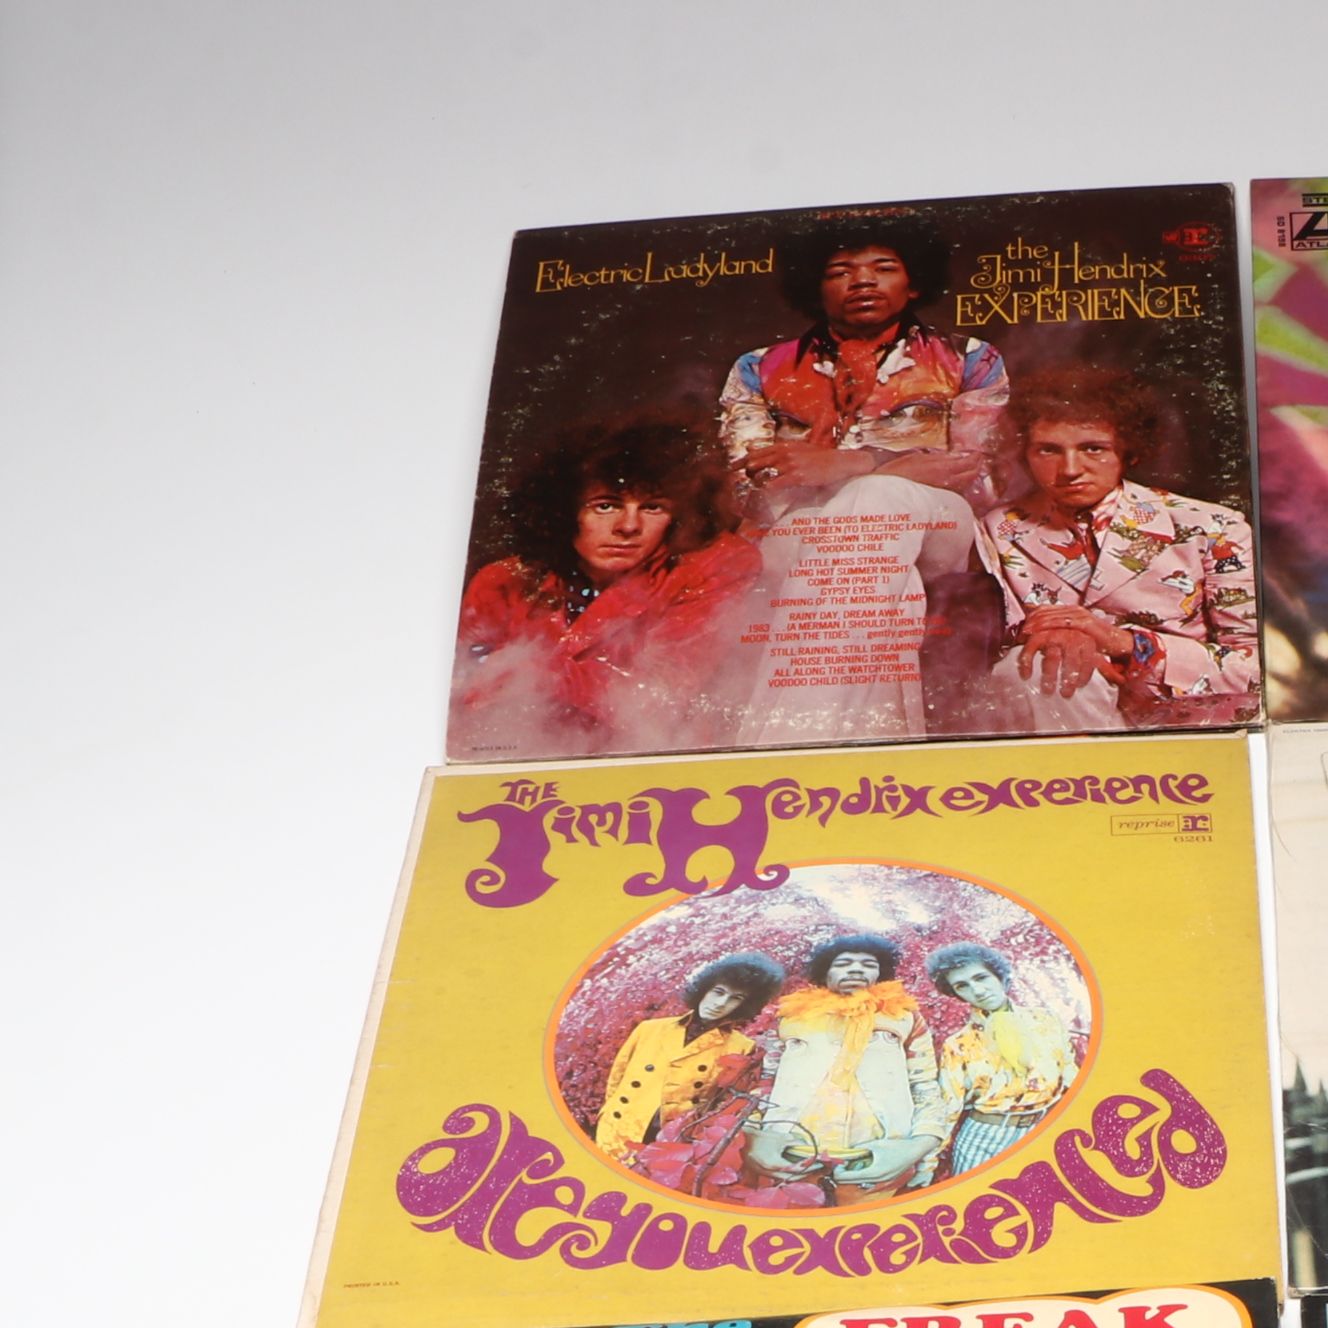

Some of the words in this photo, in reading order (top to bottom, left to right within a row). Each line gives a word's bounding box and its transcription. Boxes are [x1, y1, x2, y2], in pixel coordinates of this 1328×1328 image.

[1005, 237, 1049, 260] the
[536, 260, 644, 293] Electric
[644, 248, 773, 287] Ladyland
[970, 255, 1041, 289] Jimi
[1043, 241, 1167, 293] Hendrix
[956, 280, 1201, 326] EXPERIENCE
[791, 518, 811, 526] AND
[832, 515, 857, 524] GODS
[860, 514, 886, 523] MADE
[888, 513, 911, 521] LOVE
[772, 528, 790, 536] YOU
[792, 527, 816, 535] EVER
[818, 526, 842, 534] BEEN
[861, 524, 904, 532] ELECTRIC
[801, 534, 859, 544] CROSSTOWN
[862, 533, 900, 542] TRAFFIC
[816, 544, 855, 553] VOODOO
[857, 543, 884, 551] CHILE
[799, 559, 829, 567] LITTLE
[832, 558, 855, 566] MISS
[857, 556, 899, 565] STRANGE
[788, 569, 814, 578] LONG
[816, 568, 834, 576] HOT
[837, 566, 878, 575] SUMMER
[880, 565, 909, 573] NIGHT
[807, 578, 833, 586] COME
[836, 577, 850, 585] ON
[852, 576, 879, 585] (PART
[820, 587, 850, 596] GYPSY
[853, 586, 876, 594] EYES
[770, 598, 813, 607] BURNING
[815, 597, 828, 605] OF
[830, 596, 848, 604] THE
[850, 594, 897, 604] MIDNIGHT
[899, 593, 927, 602] LAMP
[789, 612, 817, 621] RAINY
[843, 610, 876, 618] DREAM
[878, 608, 905, 617] AWAY
[787, 623, 797, 631] (A
[798, 621, 840, 630] MERMAN
[848, 619, 886, 628] SHOULD
[889, 618, 914, 626] TURN
[775, 632, 800, 641] TURN
[802, 632, 820, 640] THE
[823, 630, 850, 639] TIDES
[770, 648, 796, 657] STILL
[842, 645, 866, 653] STILL
[870, 643, 921, 652] DREAMING
[790, 657, 822, 665] HOUSE
[824, 655, 868, 664] BURNING
[870, 653, 900, 662] DOWN
[774, 669, 790, 677] ALL
[793, 667, 825, 676] ALONG
[828, 666, 847, 675] THE
[848, 663, 915, 673] WATCHTOWER
[768, 678, 808, 688] VOODOO
[809, 676, 838, 686] CHILD
[840, 674, 877, 685] (SLIGHT
[499, 779, 560, 807] THE
[1119, 817, 1175, 831] reprise
[457, 799, 654, 908] Jimi
